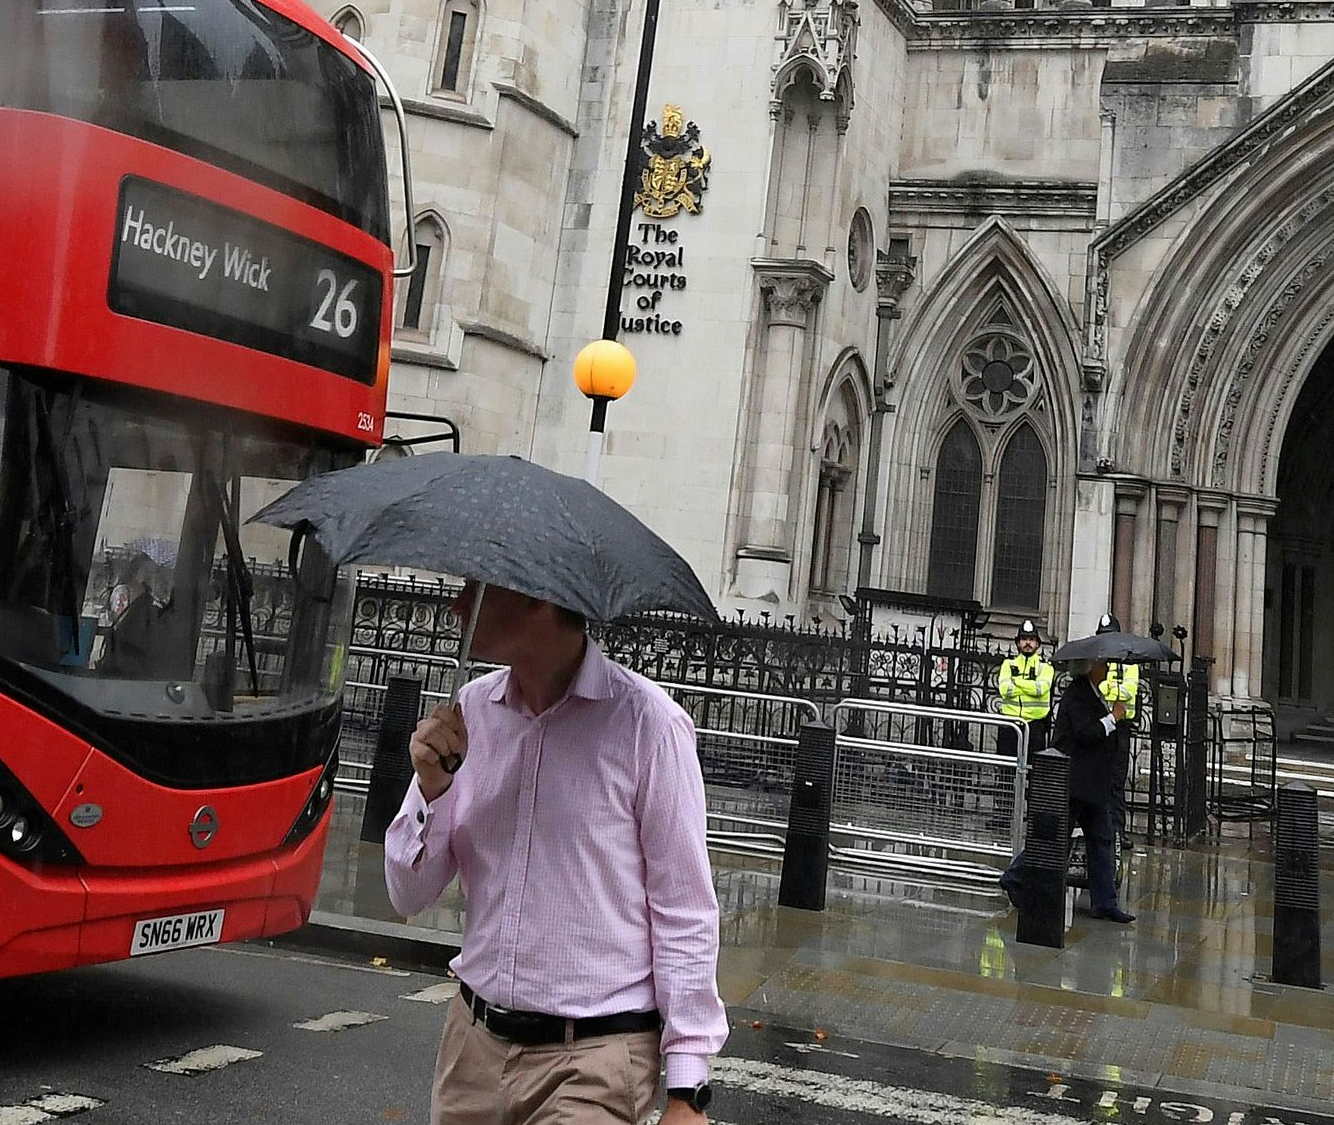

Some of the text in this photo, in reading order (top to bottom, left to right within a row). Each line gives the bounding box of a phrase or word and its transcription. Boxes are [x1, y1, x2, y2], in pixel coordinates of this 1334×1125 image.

[638, 223, 679, 244] The
[122, 205, 273, 292] Hackney Wick
[627, 244, 684, 269] Royal
[309, 269, 358, 338] 26
[637, 290, 663, 310] of
[619, 312, 683, 335] ustice
[357, 411, 375, 432] 2534
[139, 913, 218, 949] SN66 WRX
